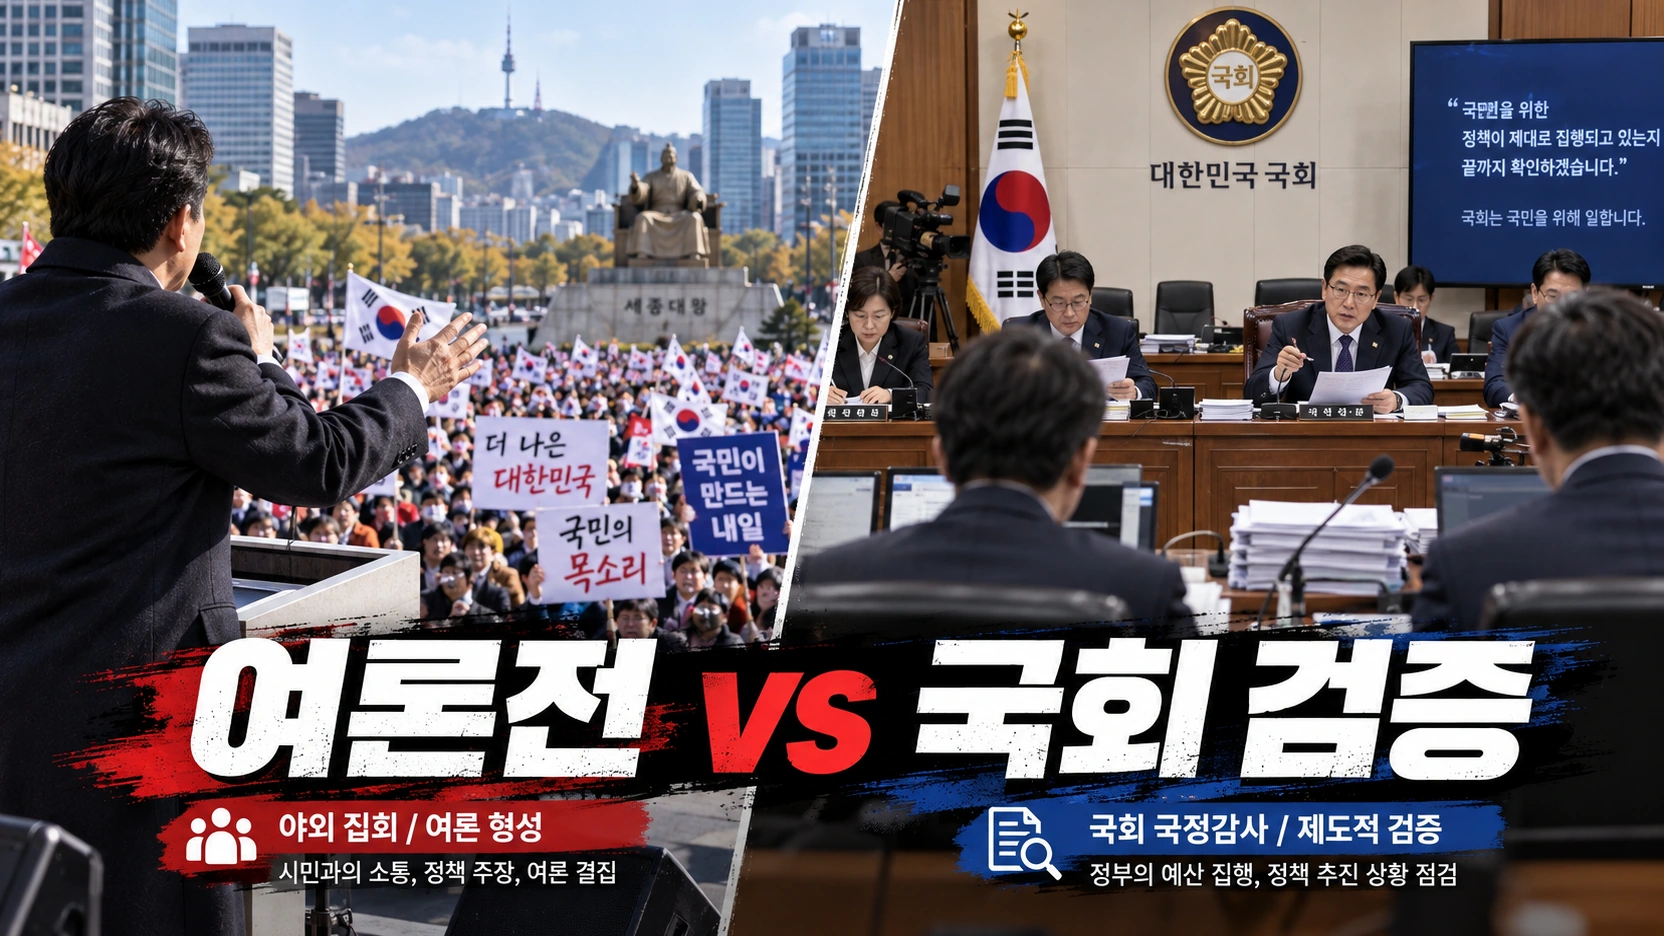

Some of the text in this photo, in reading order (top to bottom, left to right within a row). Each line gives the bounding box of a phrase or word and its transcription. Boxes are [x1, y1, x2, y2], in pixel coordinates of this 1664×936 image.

[1211, 64, 1254, 90] 국회
[1519, 100, 1549, 119] 위한
[1462, 128, 1660, 148] 정책이 제대로 집행되고 있는지
[1151, 161, 1315, 189] 대한민국 국회
[1462, 158, 1627, 177] 끝까지 확인하겠습니다.”
[1462, 209, 1645, 226] 국회는 국민을 위해 일합니다.
[625, 298, 706, 315] 세종대왕
[487, 432, 566, 458] 더 나은
[693, 447, 764, 476] 국민이
[495, 464, 594, 497] 대한민국
[701, 481, 768, 508] 만드는
[560, 514, 632, 550] 국민의
[712, 512, 764, 541] 내일
[566, 553, 645, 592] 목소리
